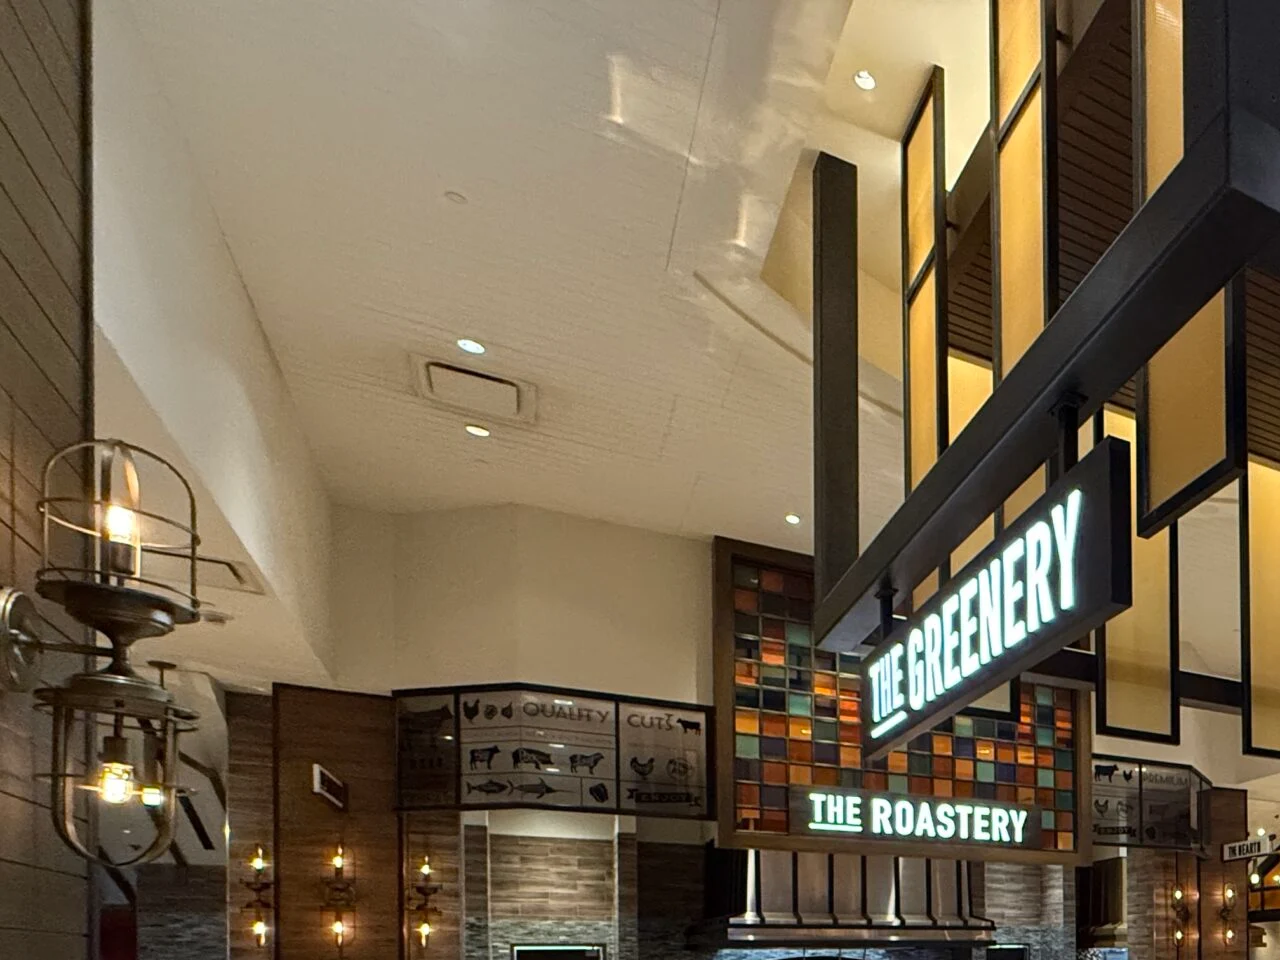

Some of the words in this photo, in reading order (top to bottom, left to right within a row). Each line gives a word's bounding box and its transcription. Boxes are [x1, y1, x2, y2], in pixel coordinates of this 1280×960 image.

[867, 643, 905, 723] THE
[907, 488, 1082, 711] GREENERY
[808, 793, 862, 826] THE
[871, 797, 1028, 843] ROASTERY
